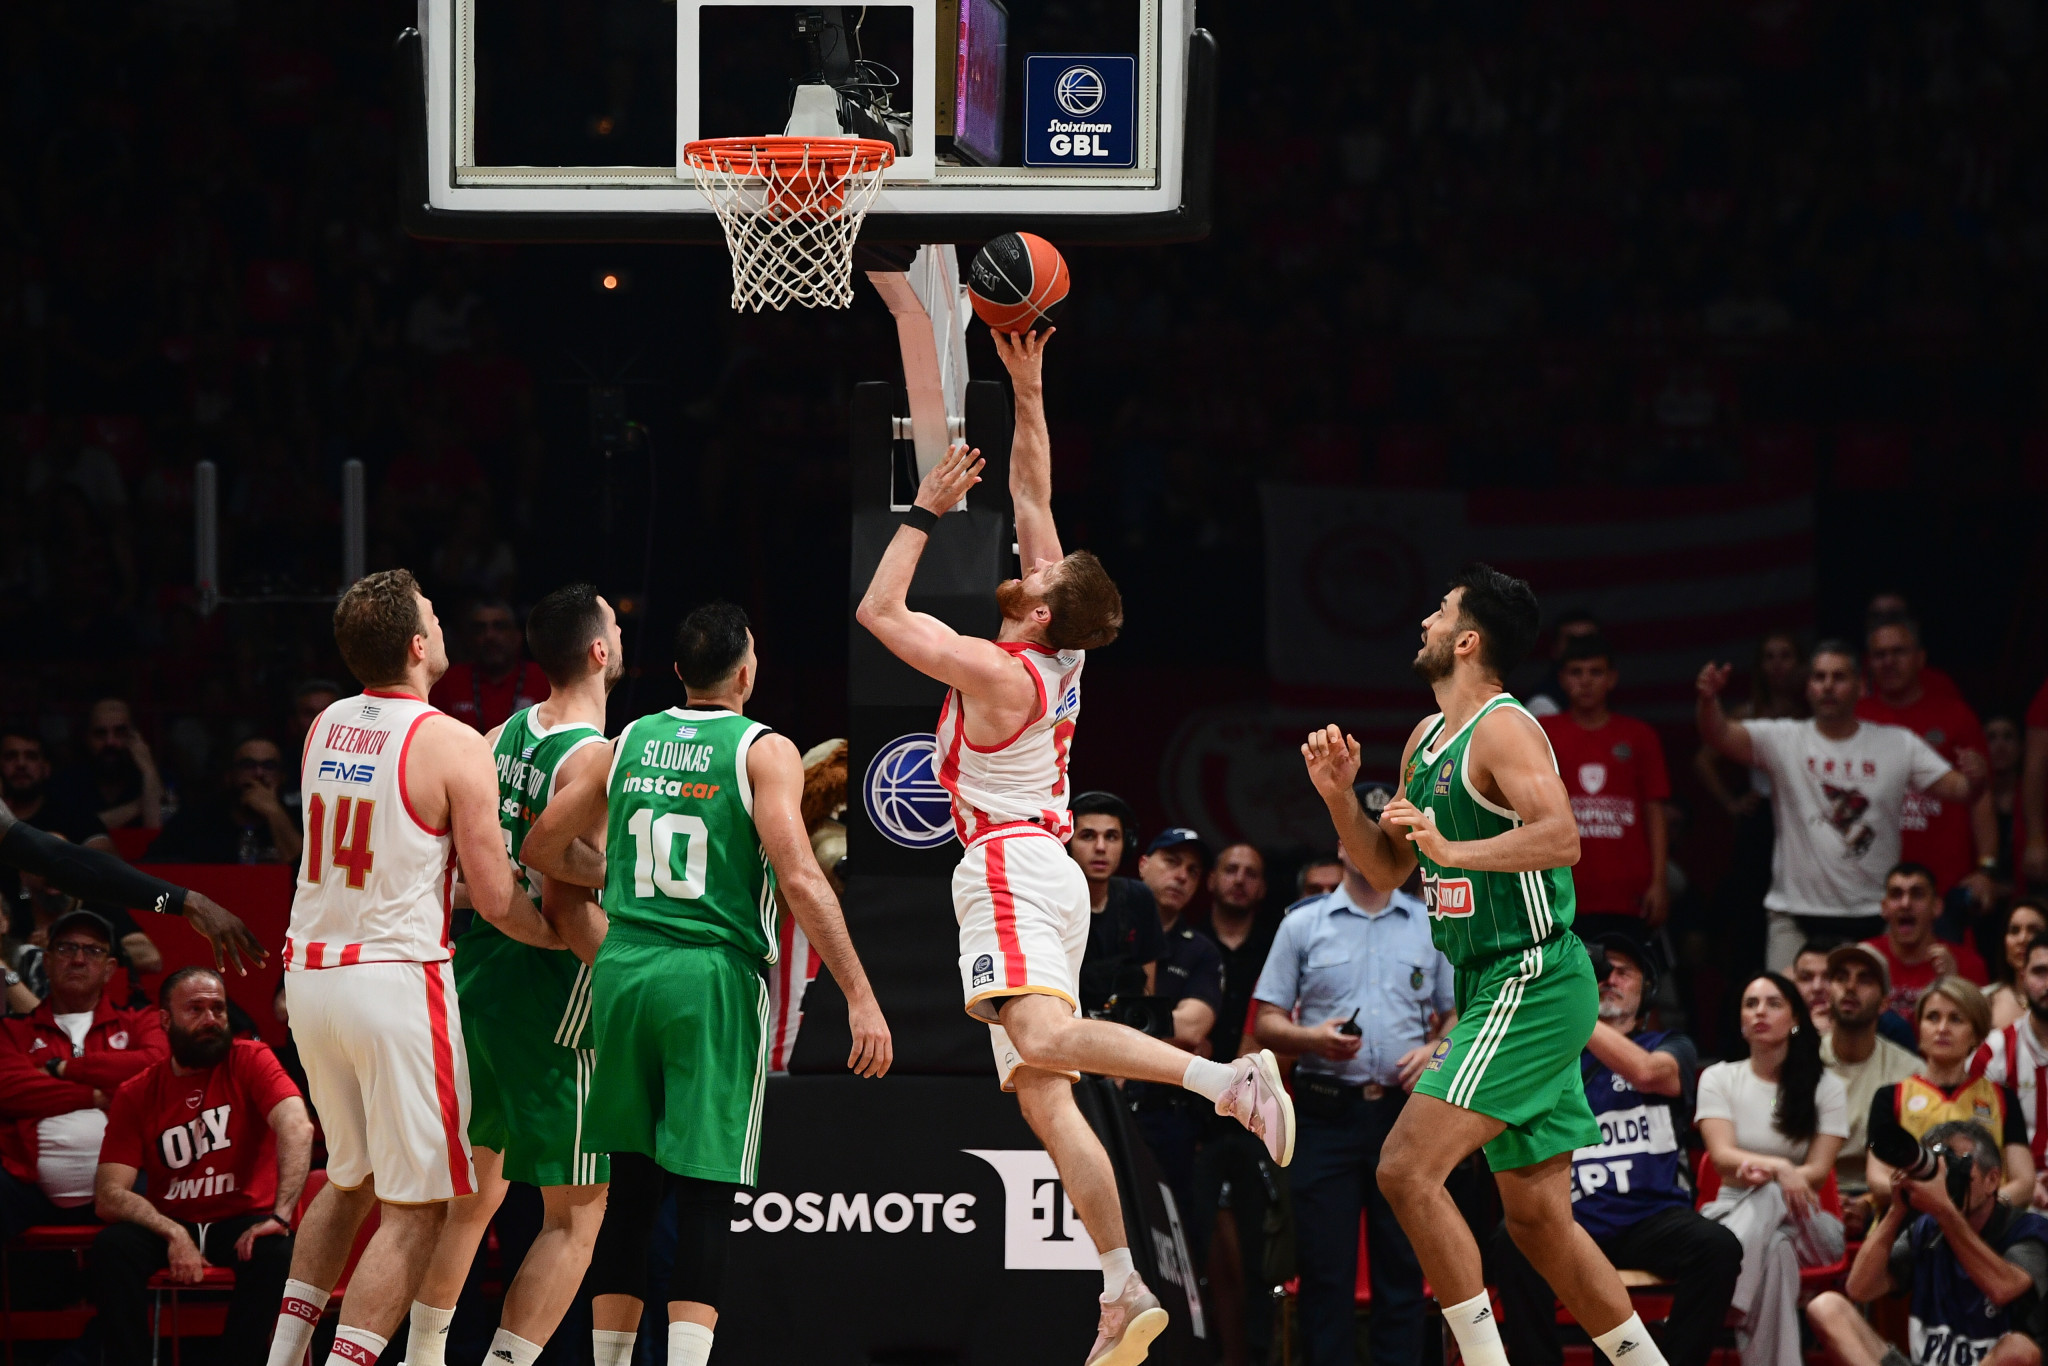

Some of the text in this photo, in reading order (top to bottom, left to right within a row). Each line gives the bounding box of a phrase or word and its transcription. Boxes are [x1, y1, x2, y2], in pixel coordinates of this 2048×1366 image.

[1047, 119, 1112, 134] Stoiximan
[1049, 134, 1109, 157] GBL
[325, 723, 391, 756] VEZENKOV
[640, 739, 714, 773] SLOUKAS
[318, 760, 376, 784] FMS
[622, 771, 720, 800] instacar
[1434, 784, 1449, 795] GBL
[307, 792, 377, 891] 14
[628, 808, 709, 900] 10
[973, 975, 993, 987] GBL
[161, 1104, 232, 1170] OLY
[1599, 1115, 1650, 1147] OLDE
[163, 1166, 236, 1201] bwin
[730, 1191, 977, 1234] COSMOTE
[287, 1300, 321, 1322] GSA
[332, 1340, 367, 1364] GSA
